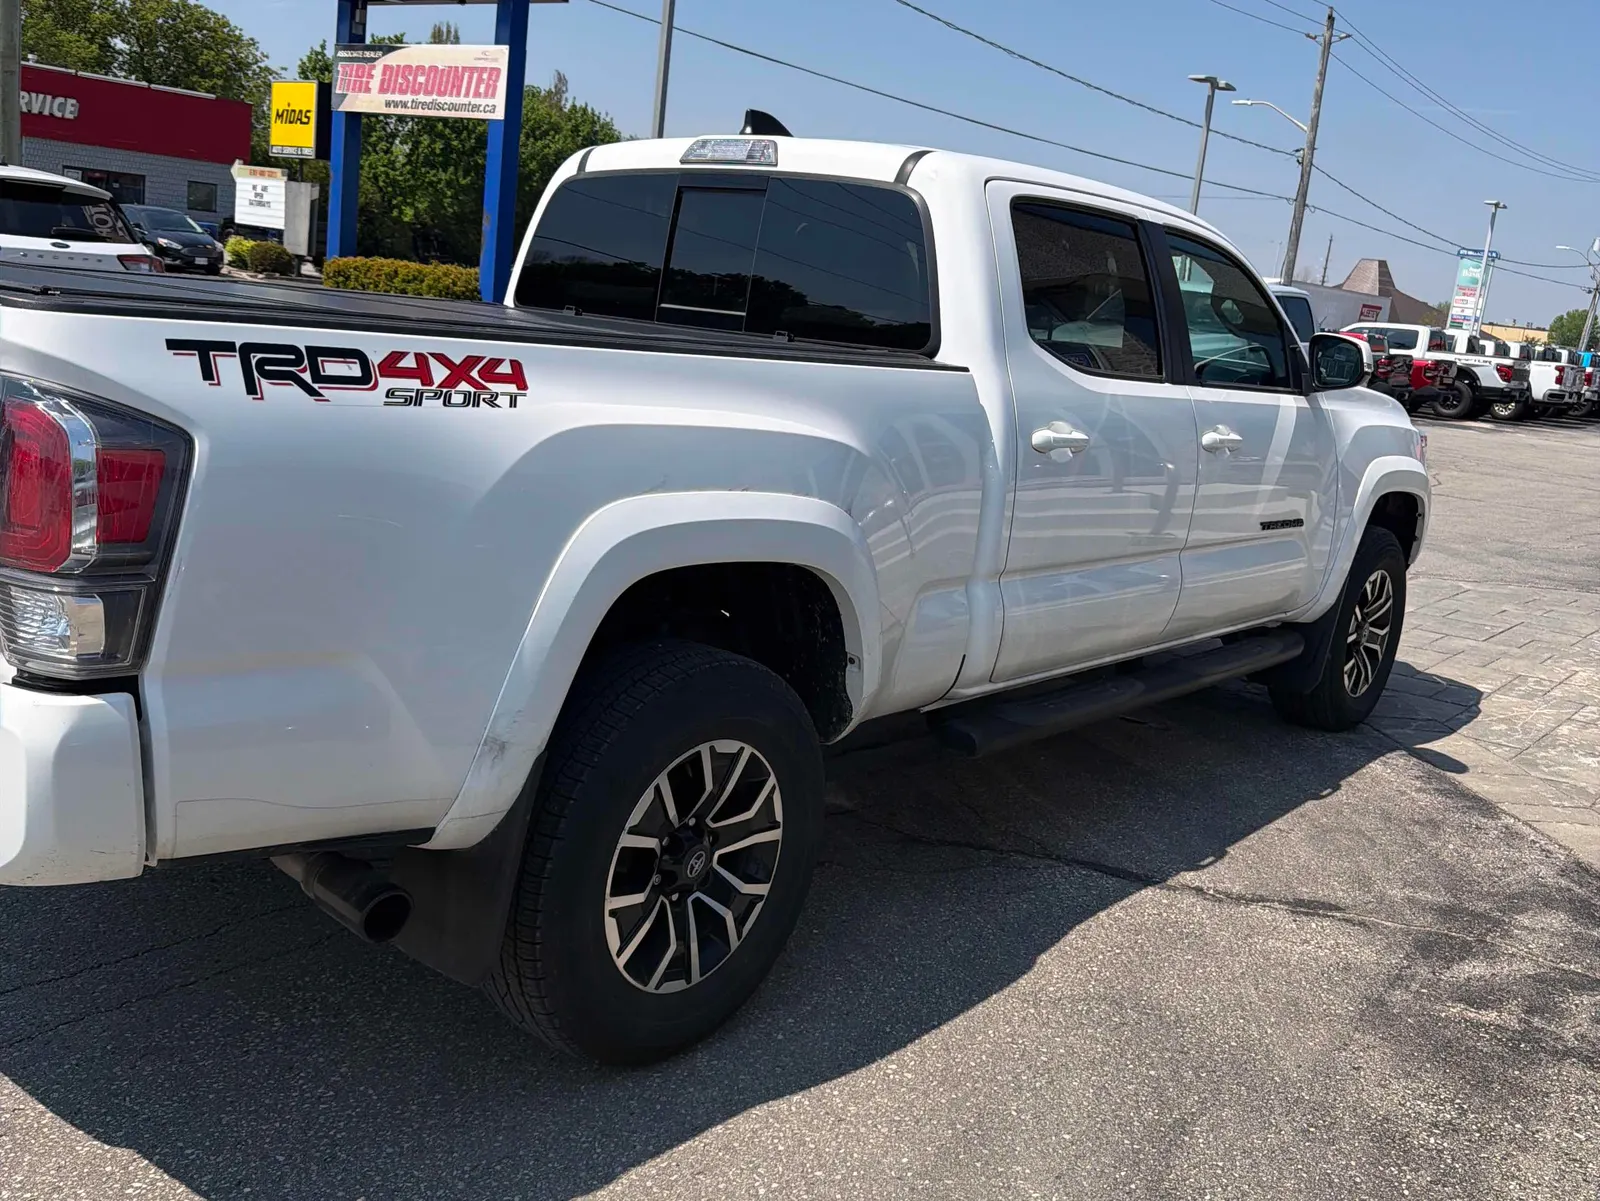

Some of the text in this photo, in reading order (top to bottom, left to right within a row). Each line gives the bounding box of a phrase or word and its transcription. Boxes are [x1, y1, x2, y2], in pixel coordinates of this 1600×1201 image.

[336, 63, 502, 99] TIRE DISCOUNTER
[274, 102, 313, 126] MIDAS
[384, 98, 497, 115] www.tirediscounter.ca
[165, 338, 530, 402] TRD 4X4
[383, 388, 528, 409] SPORT
[1260, 518, 1305, 531] TACOMA
